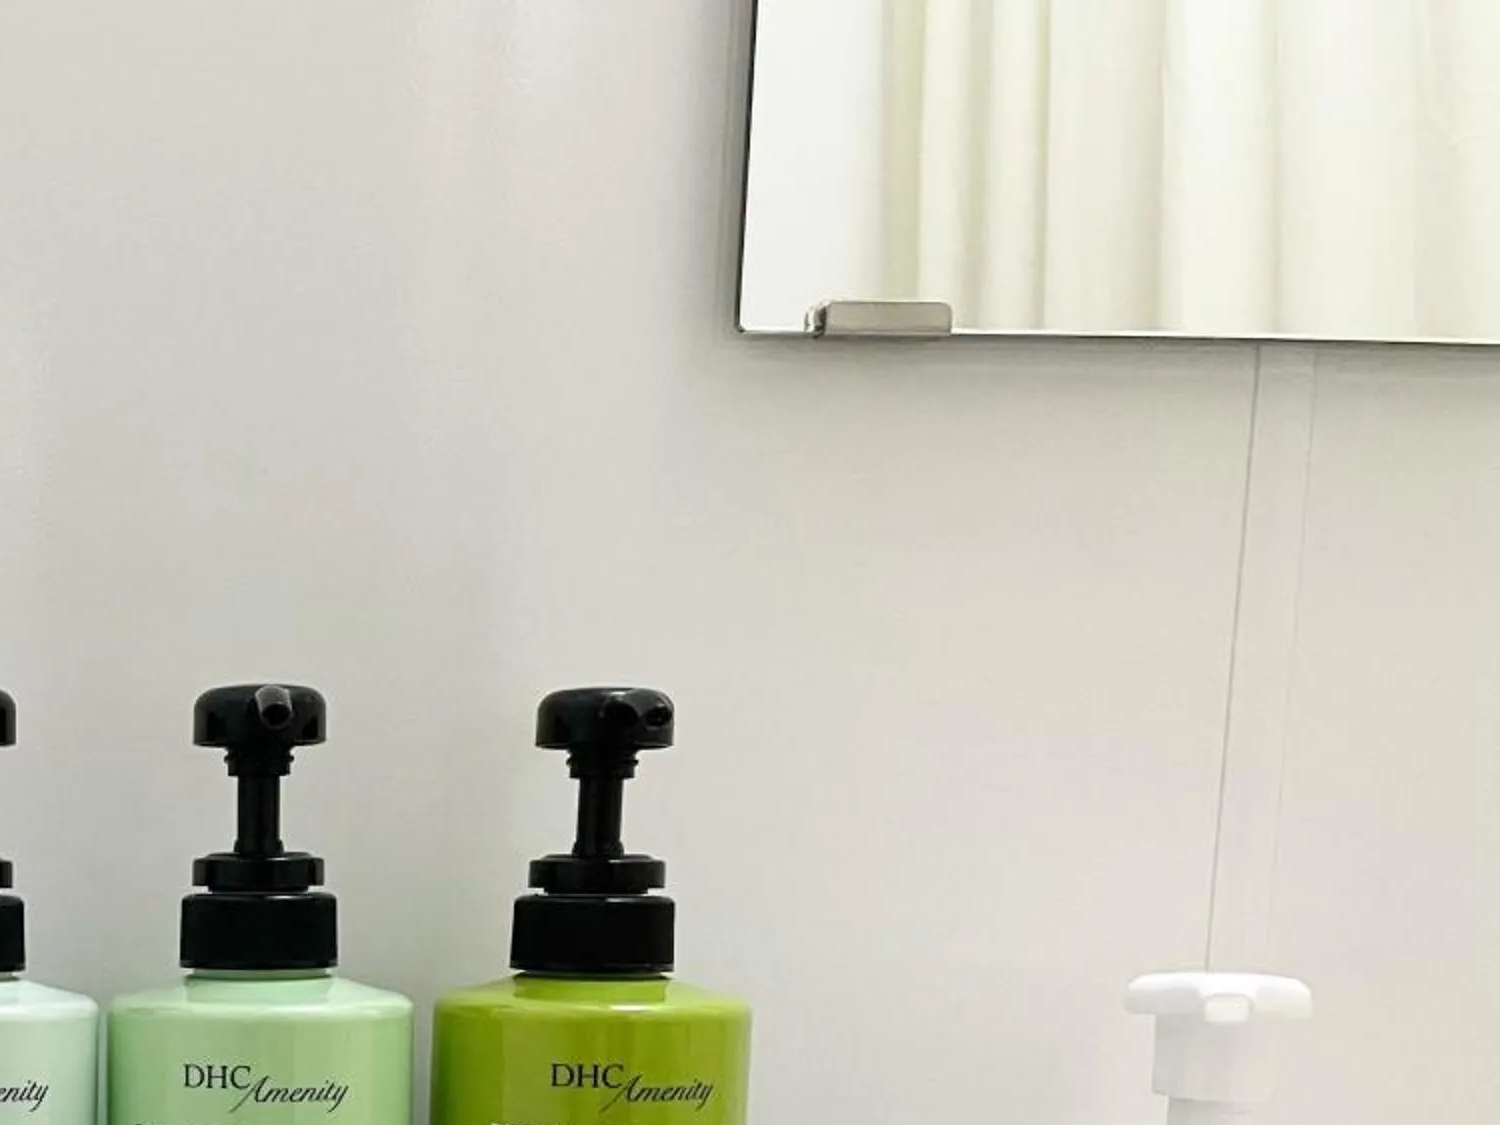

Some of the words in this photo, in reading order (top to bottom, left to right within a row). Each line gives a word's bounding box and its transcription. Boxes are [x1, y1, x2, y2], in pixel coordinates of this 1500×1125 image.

[183, 1064, 252, 1090] DHC
[229, 1076, 349, 1113] Amenity
[551, 1063, 624, 1089] DHC
[599, 1076, 714, 1113] Amenity
